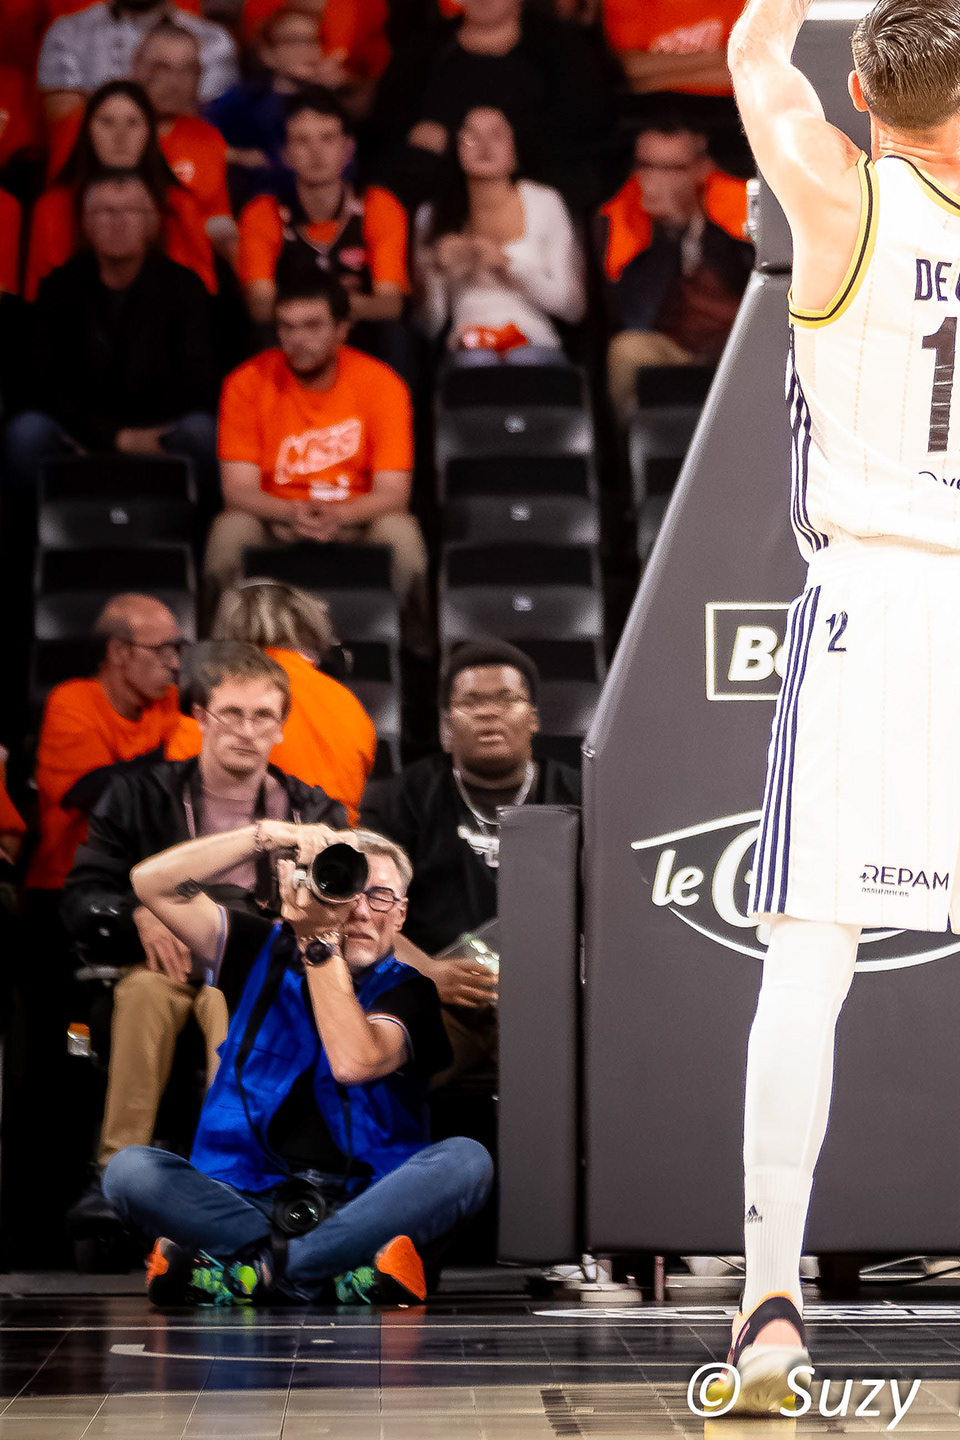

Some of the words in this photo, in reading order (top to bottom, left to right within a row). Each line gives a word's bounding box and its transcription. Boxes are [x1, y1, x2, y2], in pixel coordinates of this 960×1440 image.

[914, 258, 952, 302] DE
[825, 611, 849, 653] 12
[652, 849, 704, 907] le
[860, 864, 949, 891] REPAM
